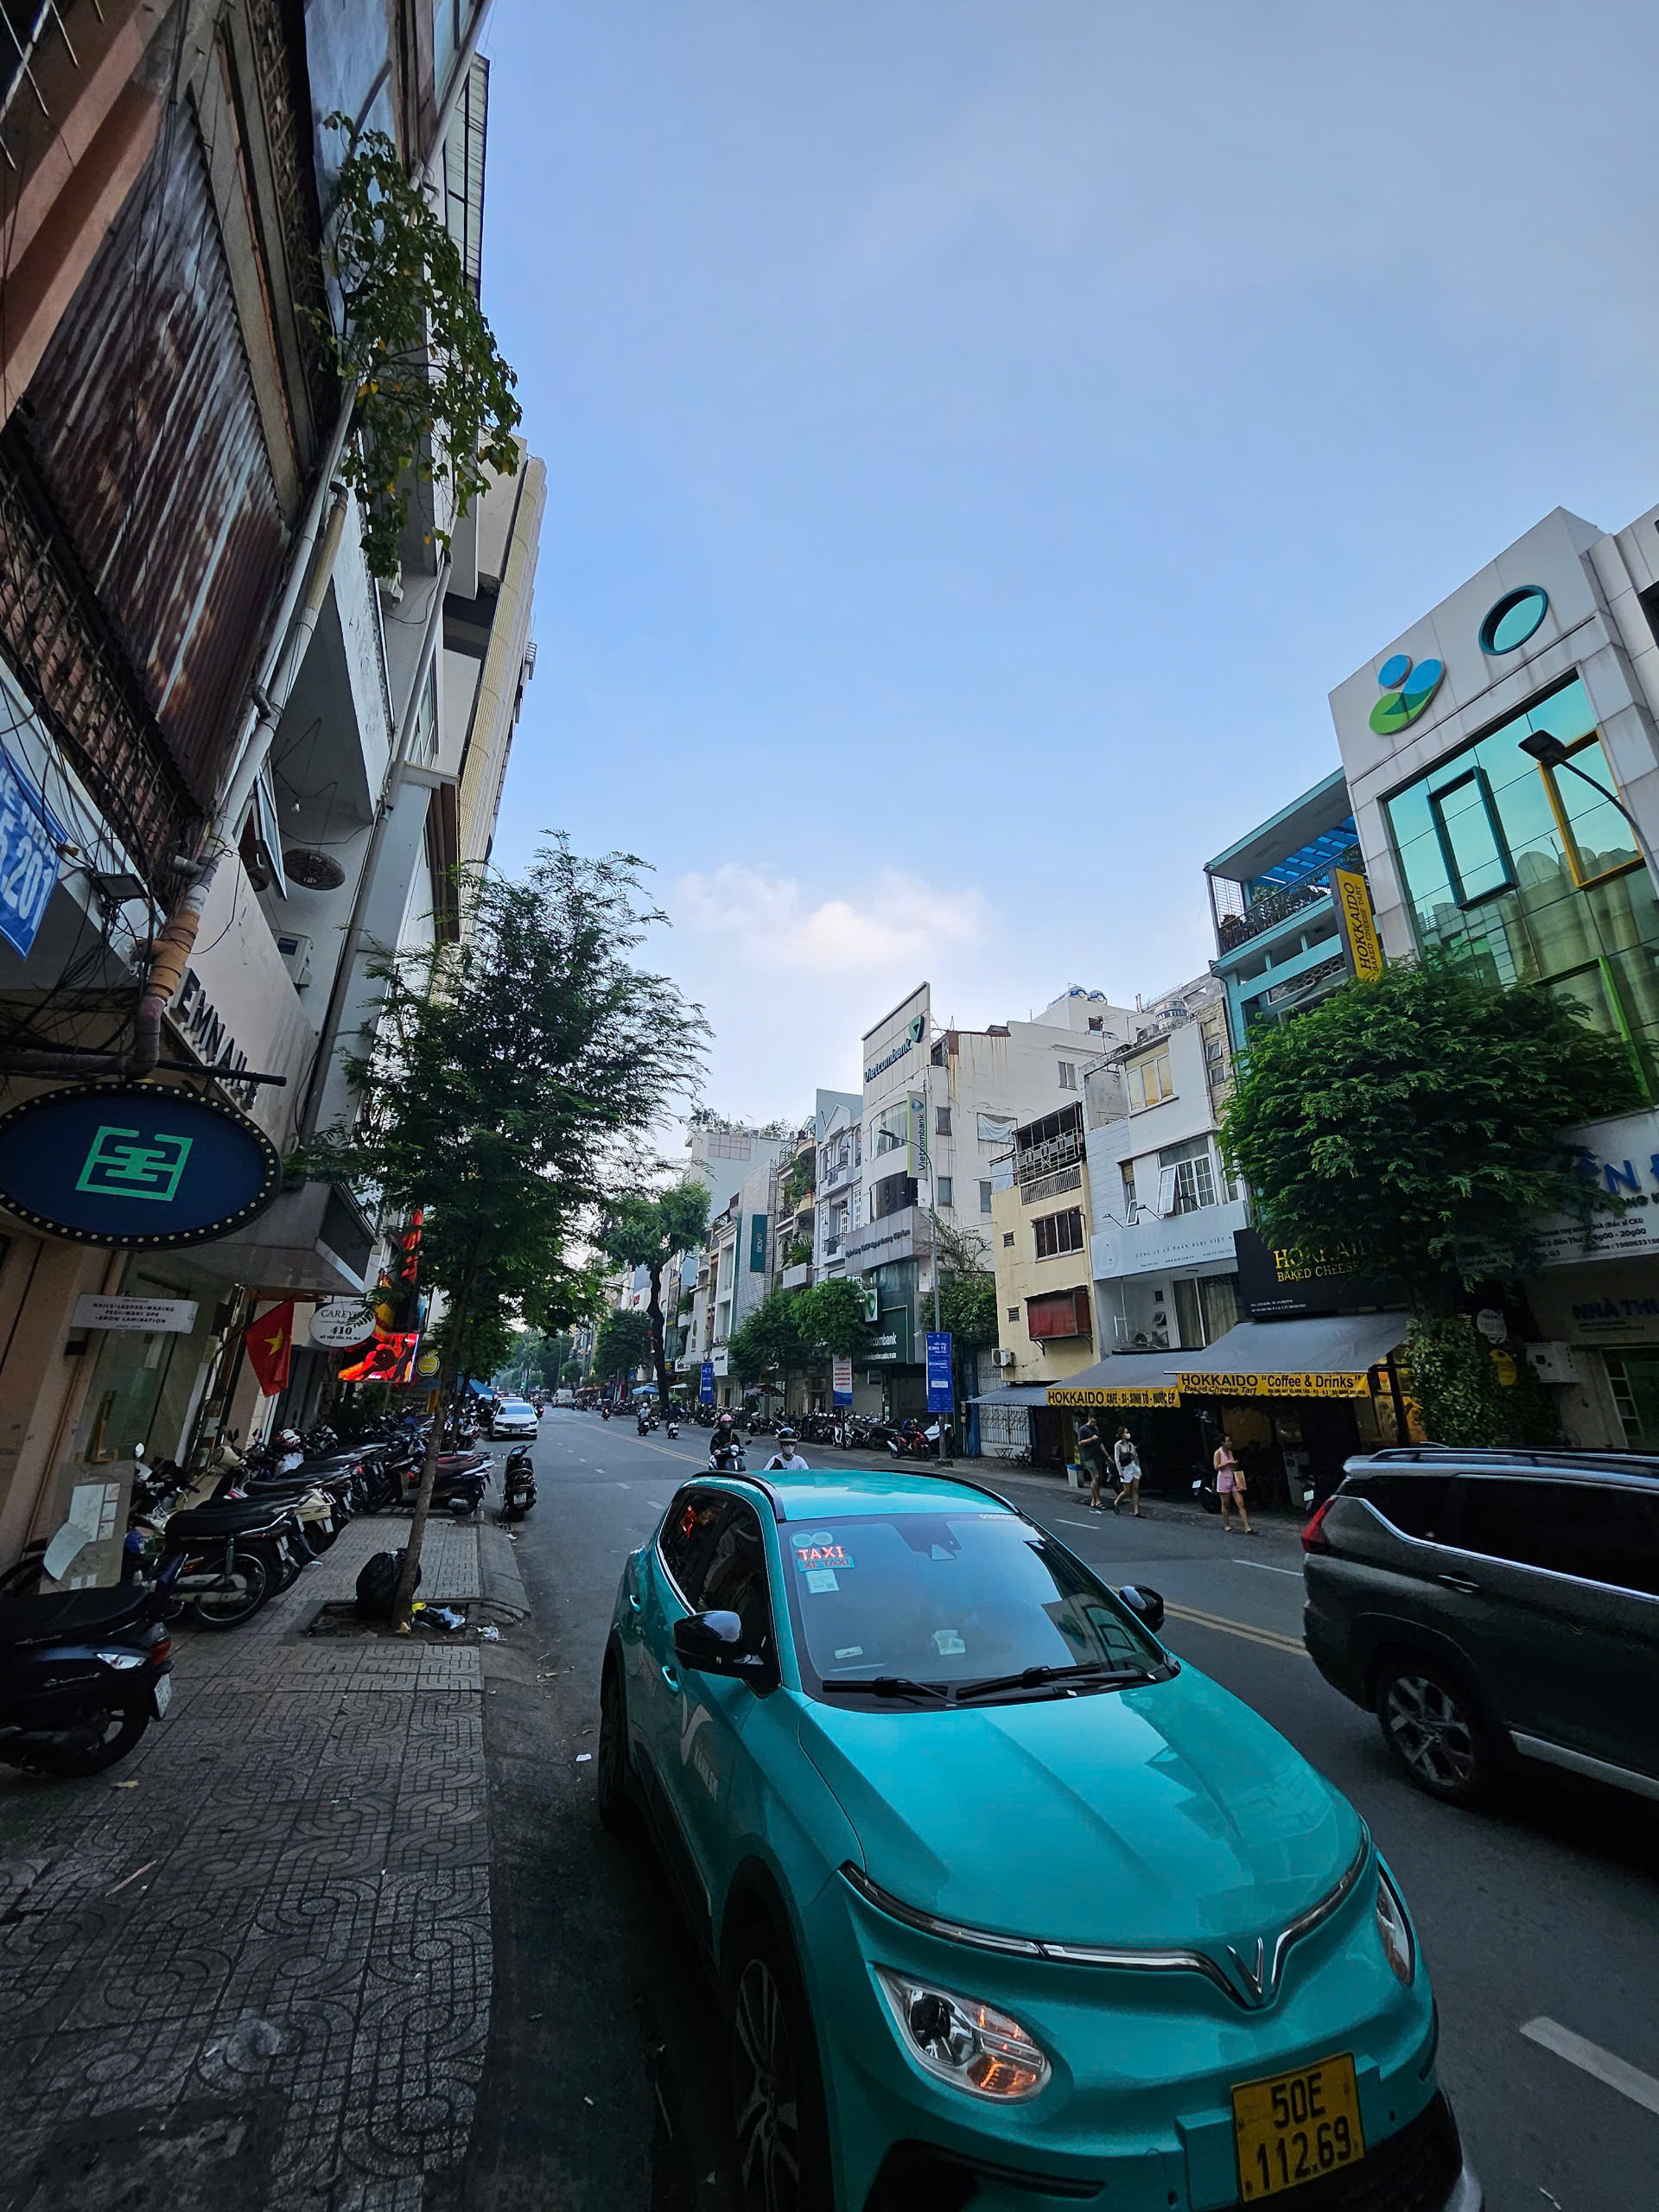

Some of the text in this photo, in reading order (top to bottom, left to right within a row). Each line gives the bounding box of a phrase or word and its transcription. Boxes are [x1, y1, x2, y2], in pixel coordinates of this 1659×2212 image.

[1354, 884, 1365, 906] TART
[1344, 881, 1372, 971] HOKKAIDO
[1359, 907, 1372, 942] CHEESE
[864, 1037, 913, 1084] Vietcombank
[917, 1113, 926, 1172] Vietcombank
[1619, 1228, 1647, 1238] 20g00
[1135, 1250, 1151, 1259] CÔNG
[1277, 1267, 1313, 1282] BAKED
[330, 1325, 353, 1335] 410
[871, 1332, 898, 1347] combank
[1181, 1374, 1258, 1387] HOKKAIDO
[1304, 1375, 1313, 1388] &
[1183, 1384, 1258, 1394] Baked Cheese Tart
[1048, 1390, 1105, 1405] HOKKAIDO
[1141, 1389, 1149, 1404] TỐ
[1167, 1389, 1176, 1404] ÉP
[798, 1546, 844, 1561] TAXI
[1270, 2072, 1326, 2130] 50E
[1256, 2114, 1351, 2190] 112.69
